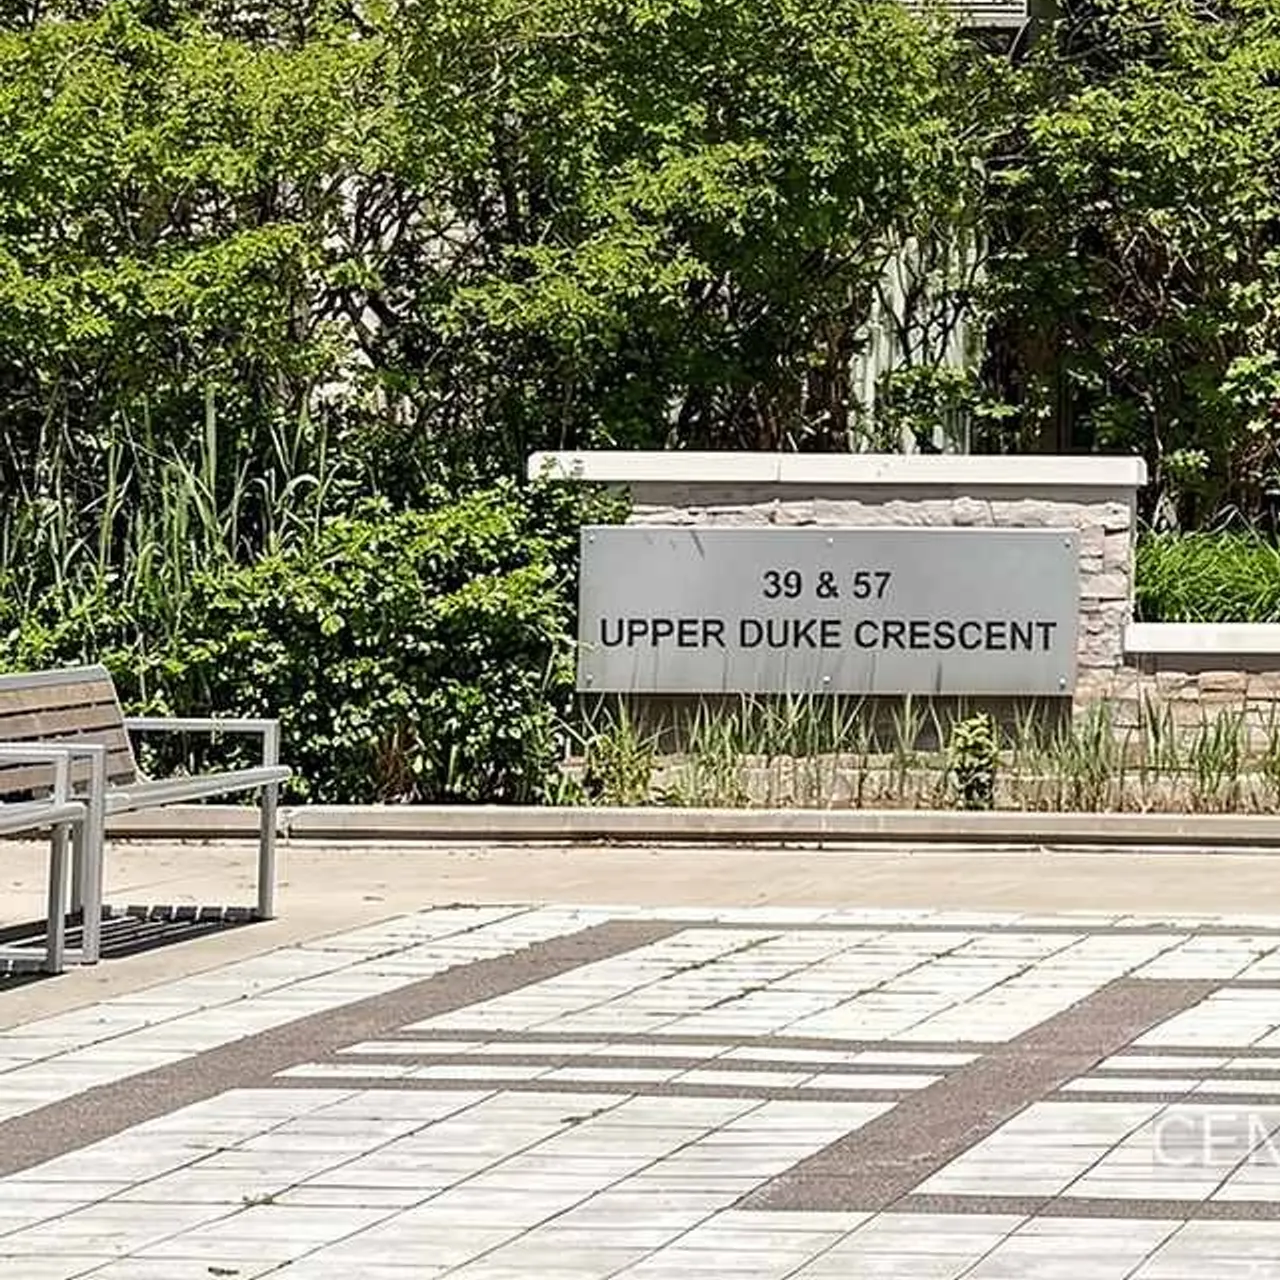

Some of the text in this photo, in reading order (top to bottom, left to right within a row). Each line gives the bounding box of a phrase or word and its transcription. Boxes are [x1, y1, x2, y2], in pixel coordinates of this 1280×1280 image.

[762, 571, 892, 600] 39 & 57
[600, 618, 1057, 651] UPPER DUKE CRESCENT
